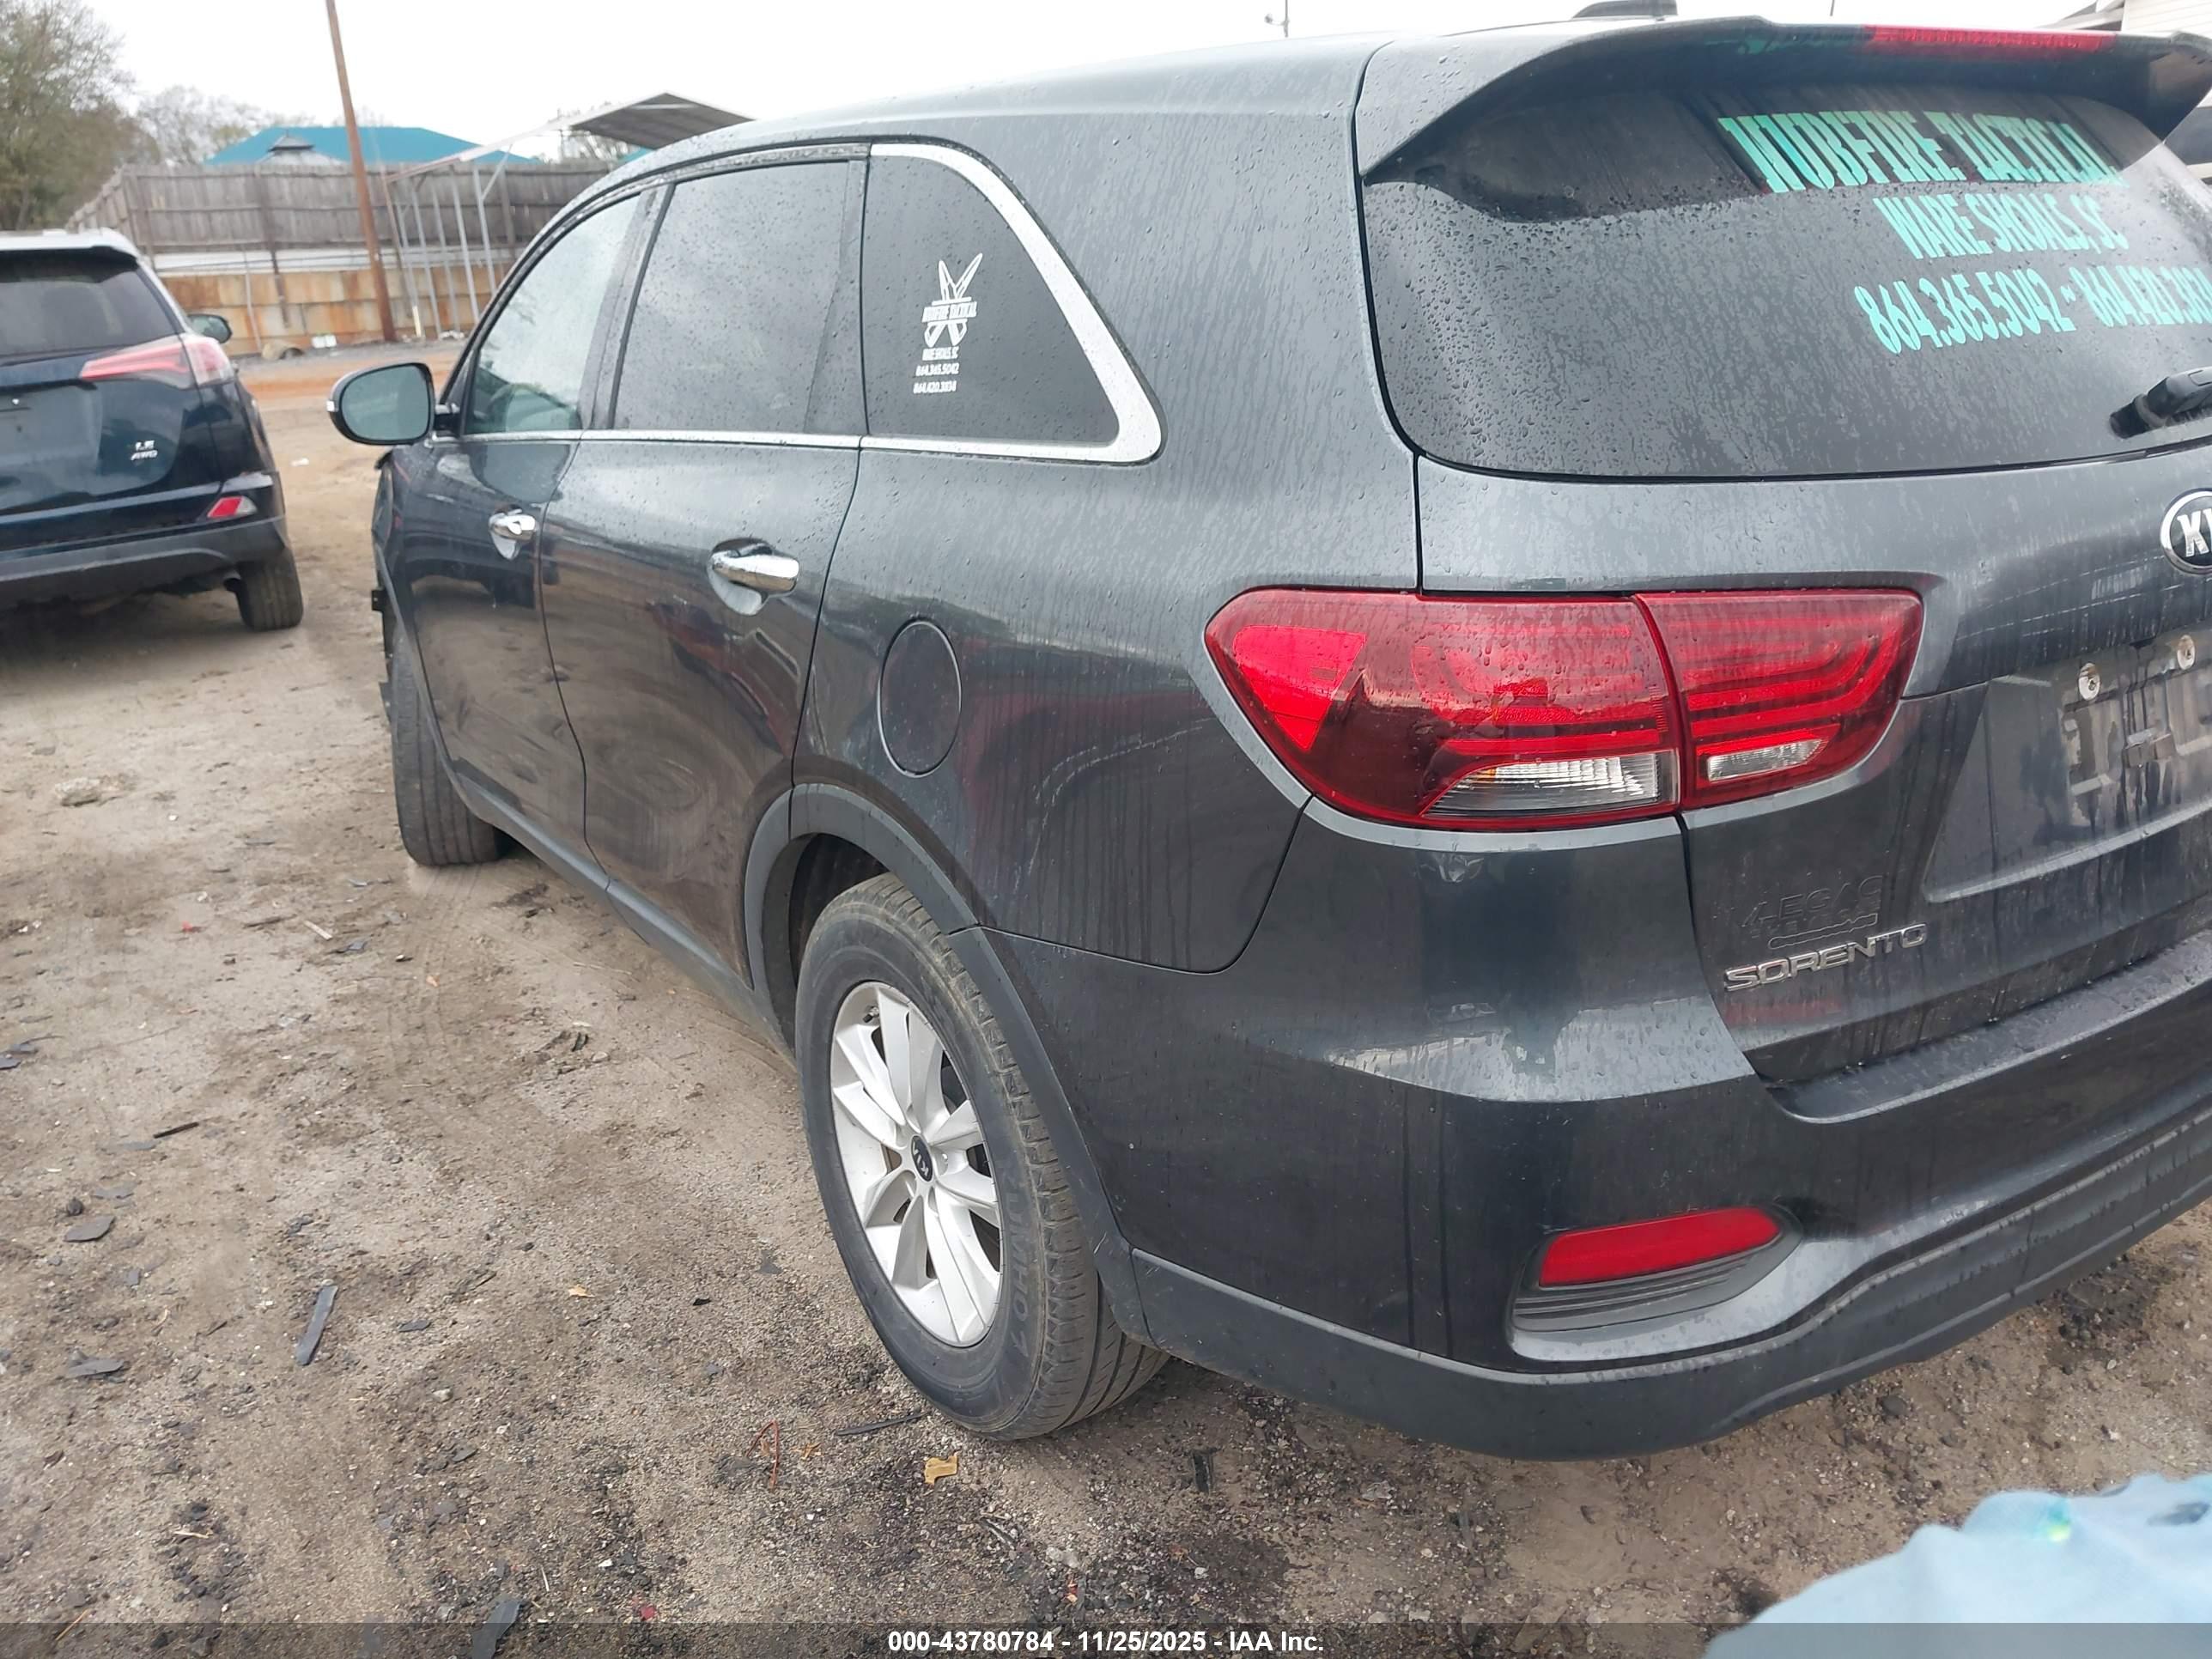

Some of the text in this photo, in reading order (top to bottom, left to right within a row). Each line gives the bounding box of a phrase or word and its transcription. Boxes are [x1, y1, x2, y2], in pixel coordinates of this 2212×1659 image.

[1923, 110, 2129, 187] TACTICAL
[1874, 195, 1992, 258] WARE
[1854, 269, 2076, 355] 864.365.5042
[131, 449, 158, 461] AWD
[1723, 923, 1928, 992] SORENTO
